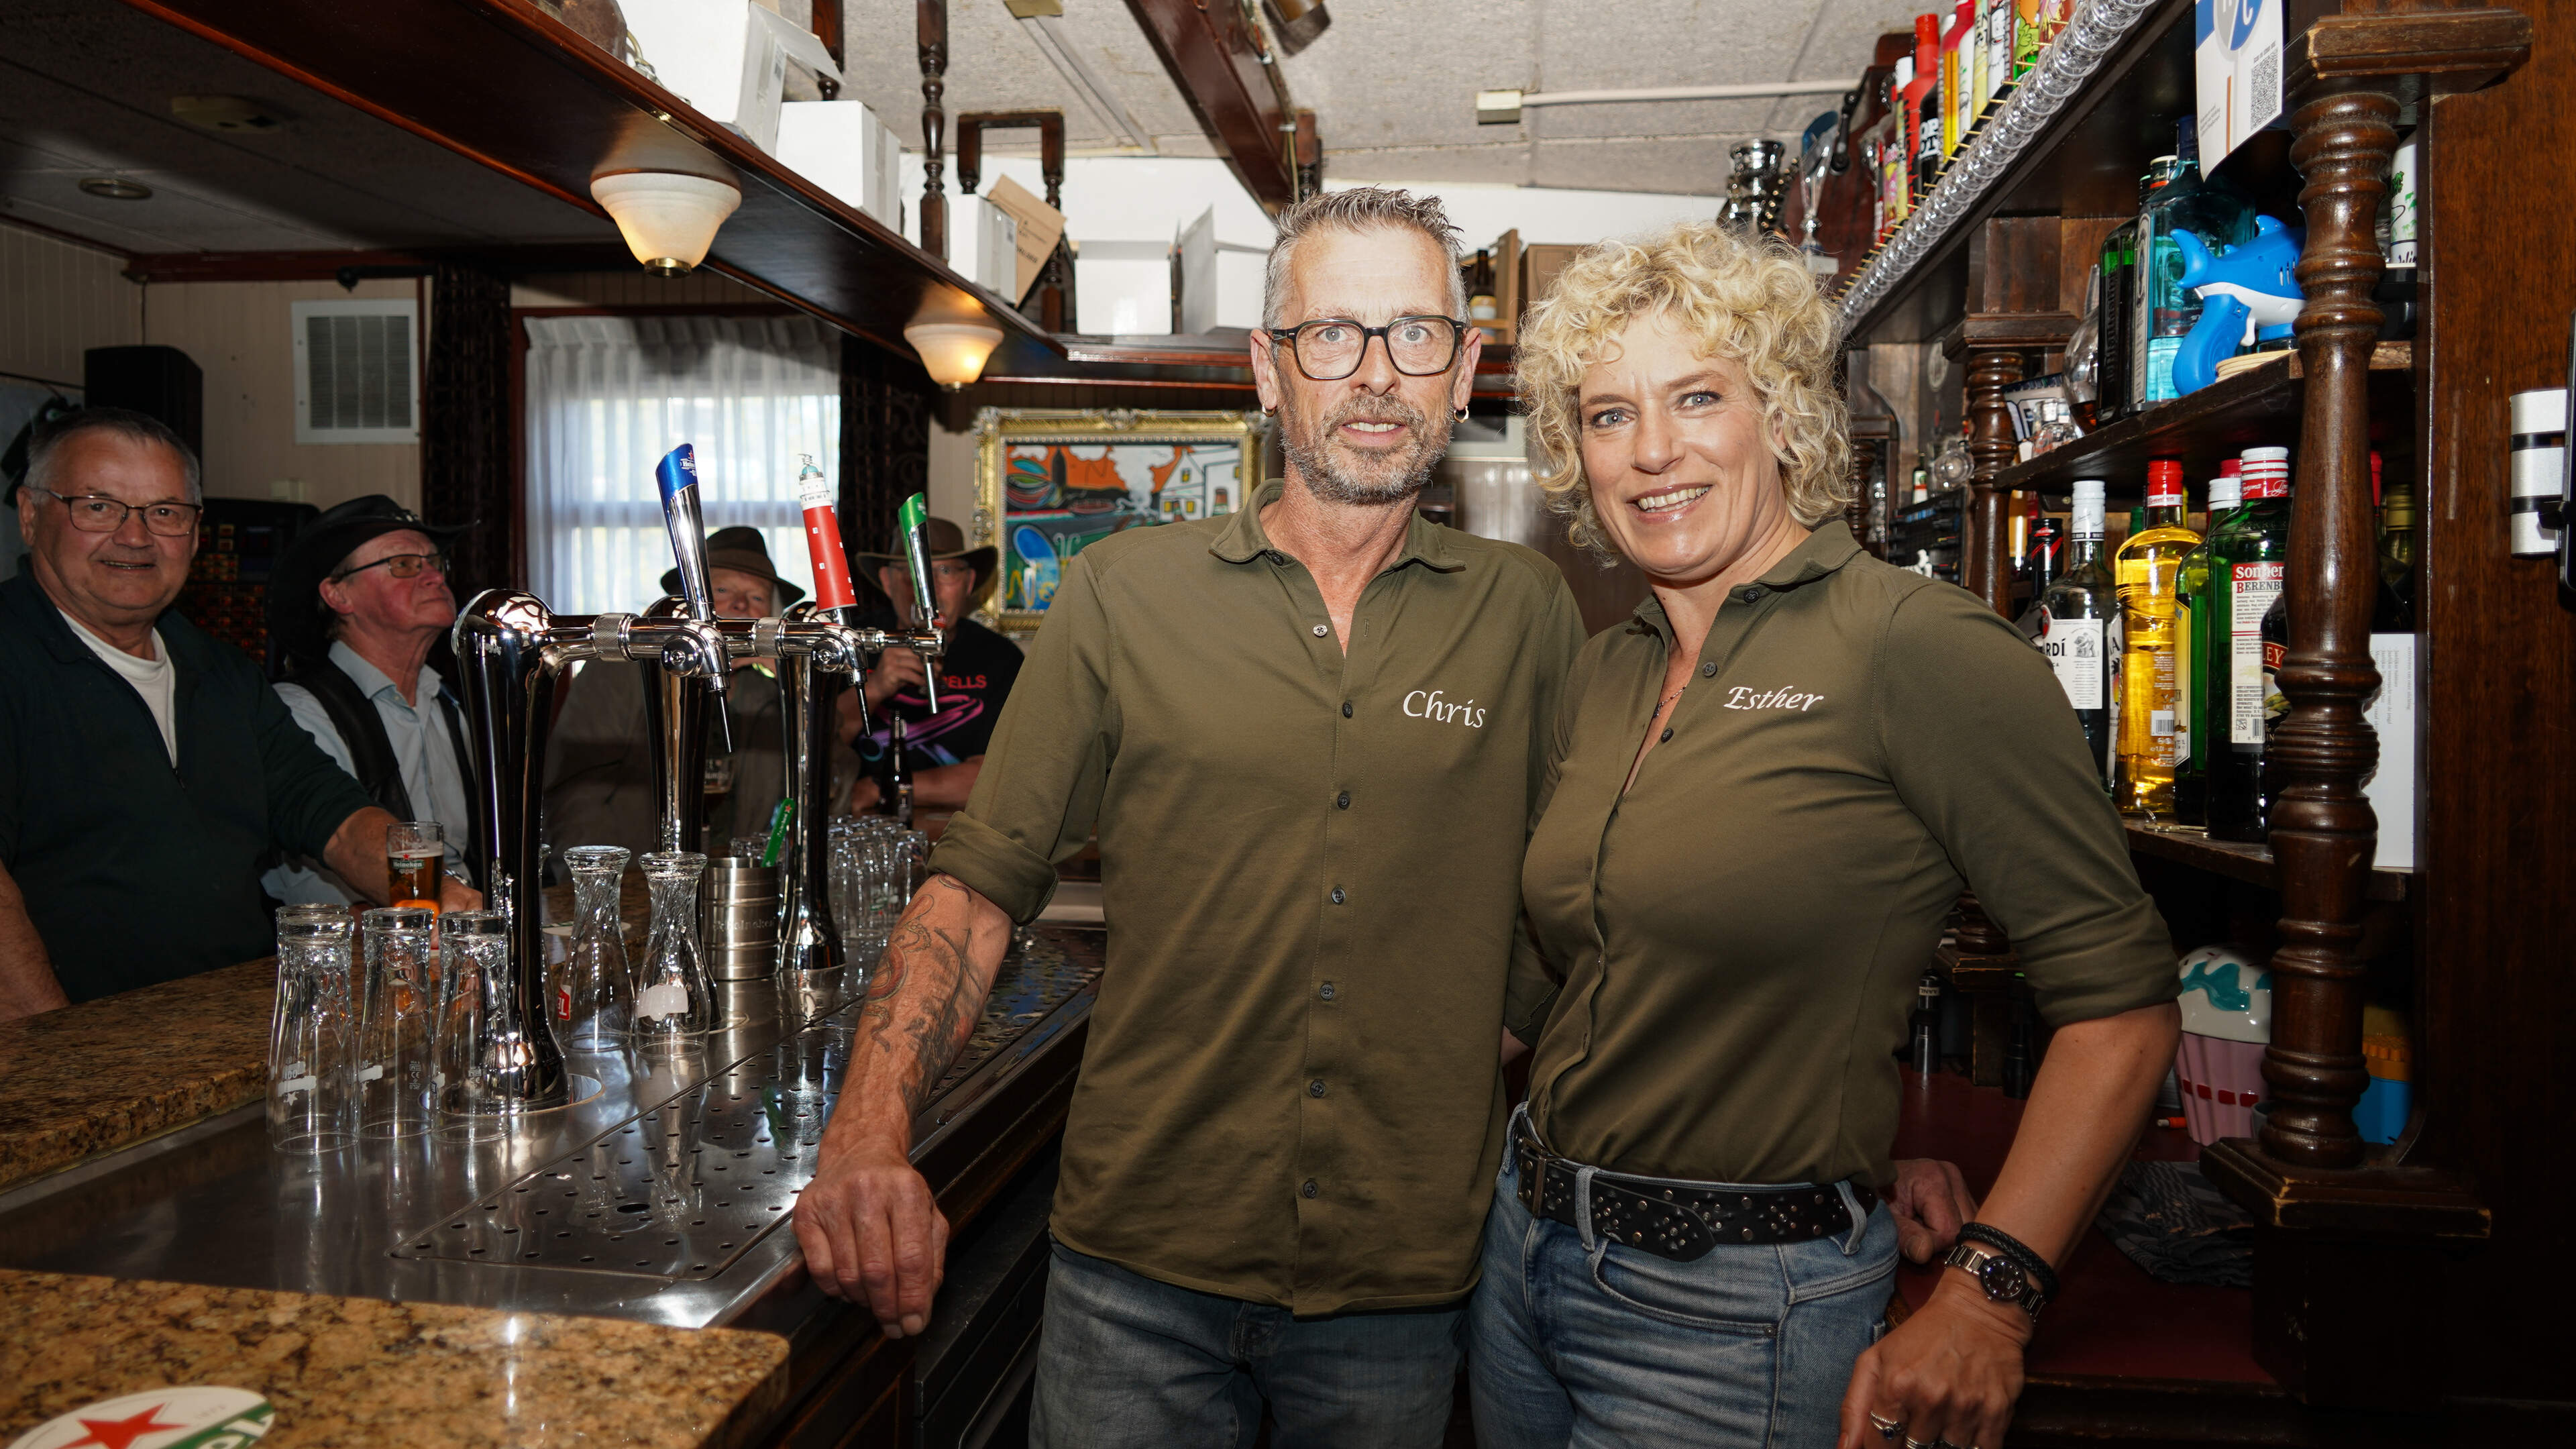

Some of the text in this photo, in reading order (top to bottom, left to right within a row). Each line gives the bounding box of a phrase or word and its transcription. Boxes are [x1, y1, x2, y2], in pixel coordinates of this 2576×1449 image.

[2236, 581, 2284, 593] BERENB
[2043, 638, 2067, 657] RDÍ
[944, 675, 987, 689] ELLS
[1723, 685, 1825, 712] Esther
[1403, 690, 1486, 728] Chris
